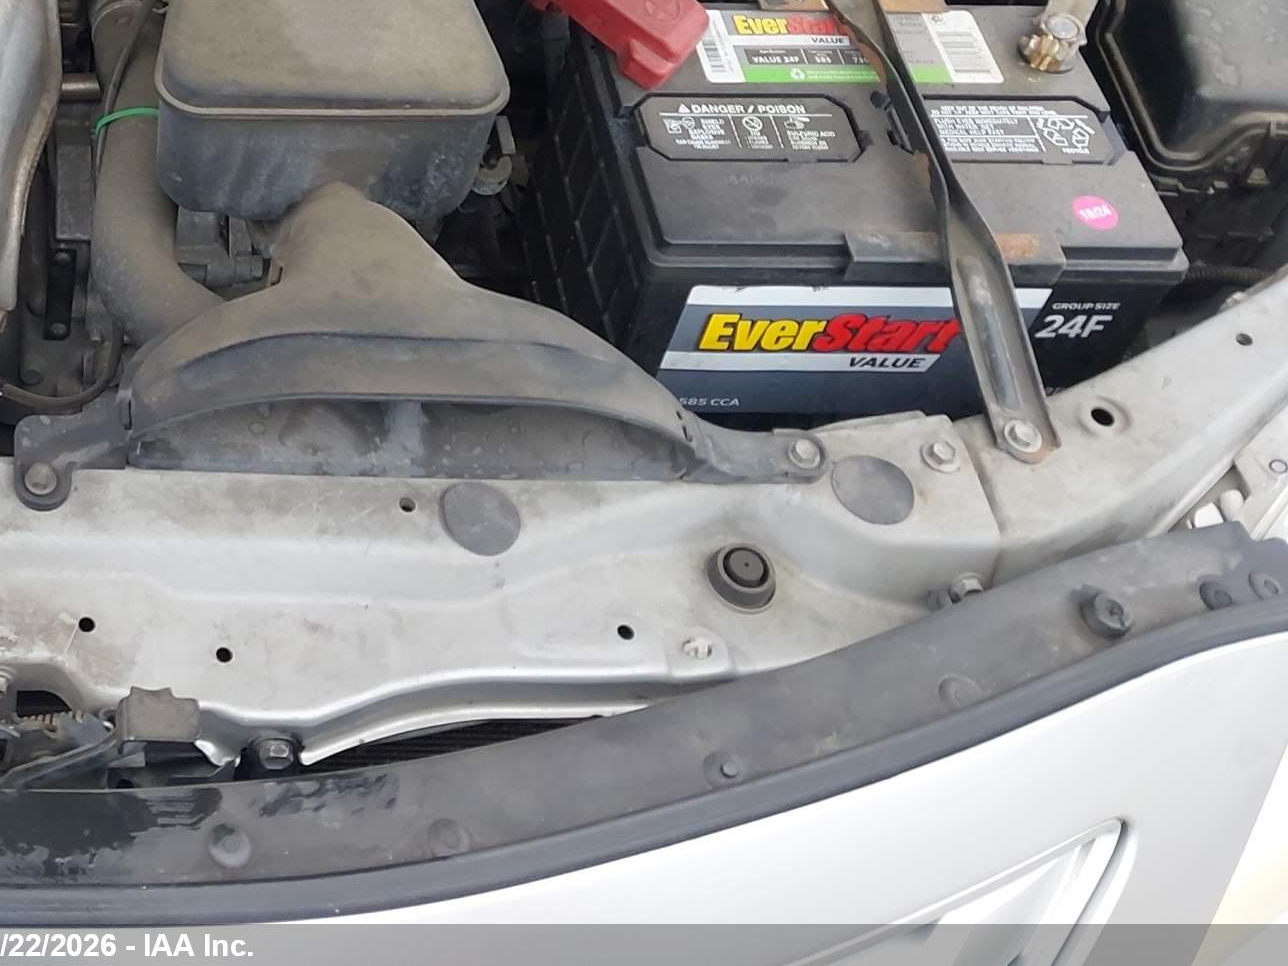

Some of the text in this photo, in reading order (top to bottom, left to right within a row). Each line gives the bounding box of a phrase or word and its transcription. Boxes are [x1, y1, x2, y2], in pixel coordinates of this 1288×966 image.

[752, 56, 780, 64] VALUE
[691, 105, 745, 113] DANGER
[758, 105, 806, 114] POISON
[1052, 302, 1121, 310] GROUP SIZE
[1034, 315, 1113, 338] 24F
[698, 313, 960, 353] EverStart
[849, 357, 926, 368] VALUE
[679, 397, 740, 406] 585 CCA
